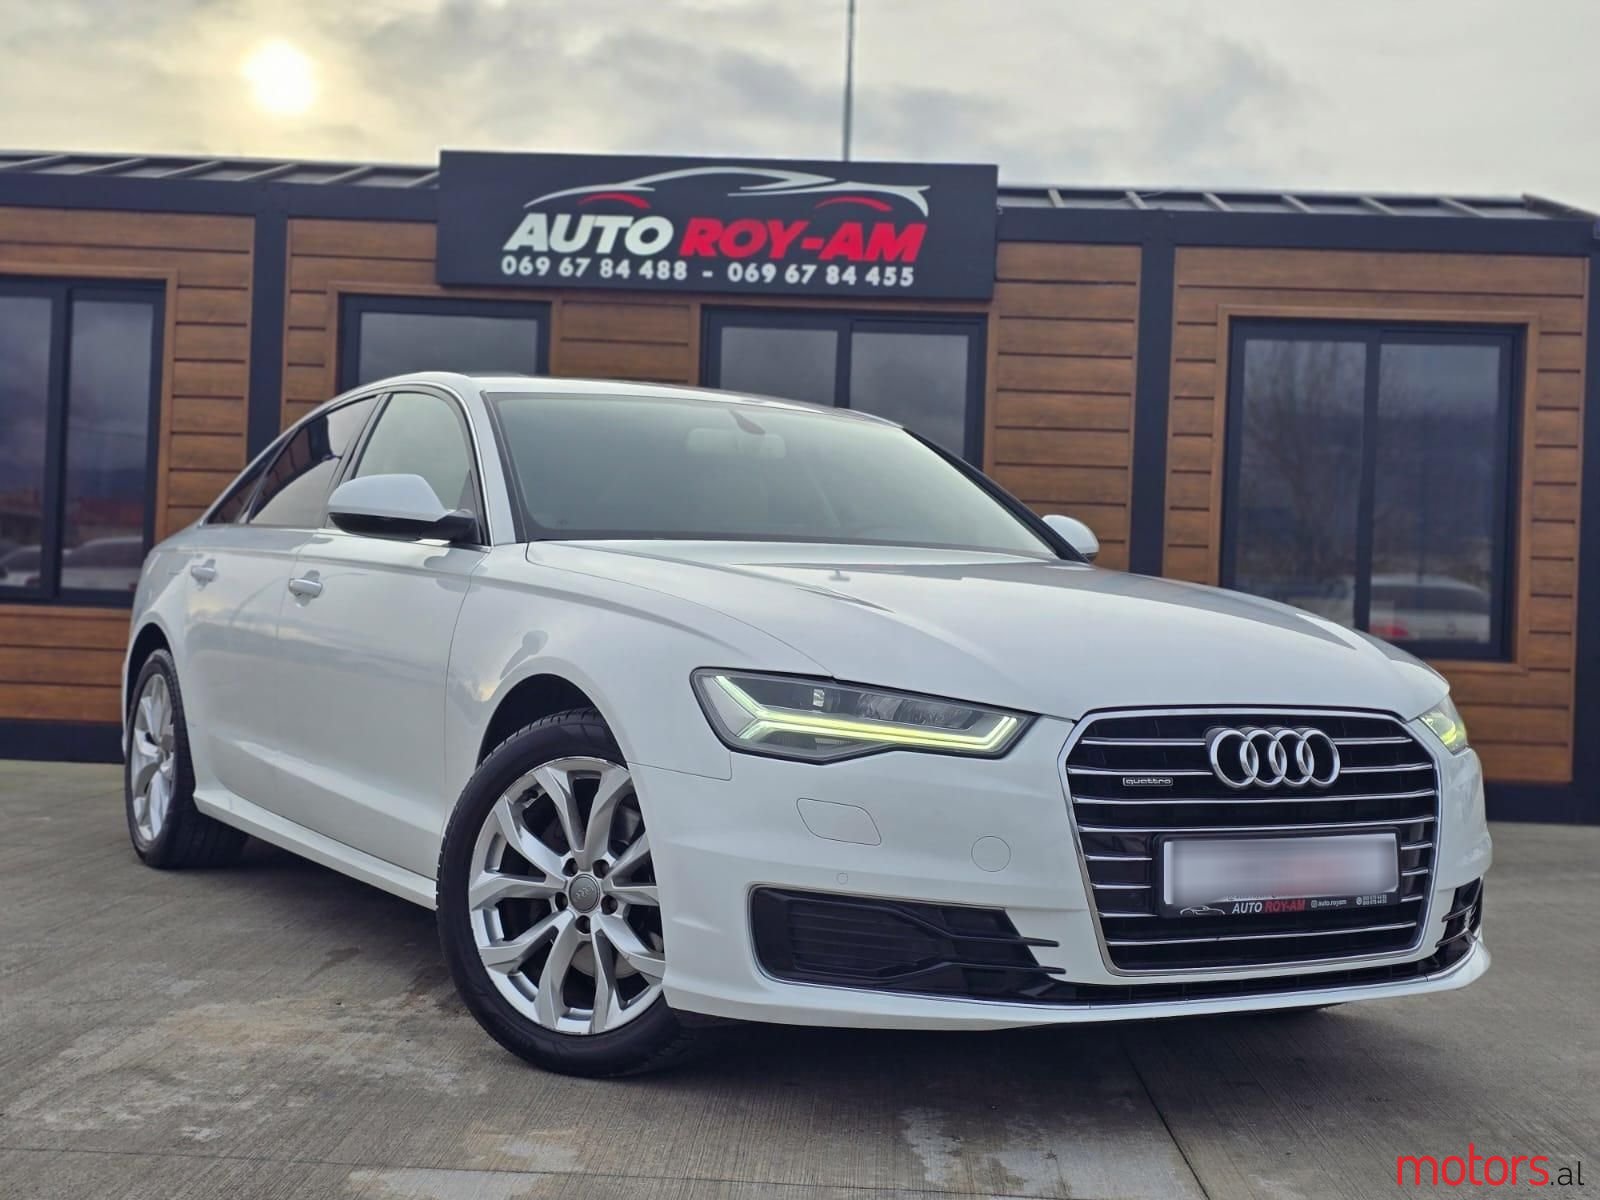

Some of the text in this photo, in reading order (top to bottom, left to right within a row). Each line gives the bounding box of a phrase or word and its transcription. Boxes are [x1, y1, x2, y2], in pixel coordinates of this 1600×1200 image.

[502, 213, 927, 262] AUTO ROY-AM
[502, 255, 914, 287] 069 67 84 488 - 069 67 84 455
[1231, 902, 1263, 914] AUTO
